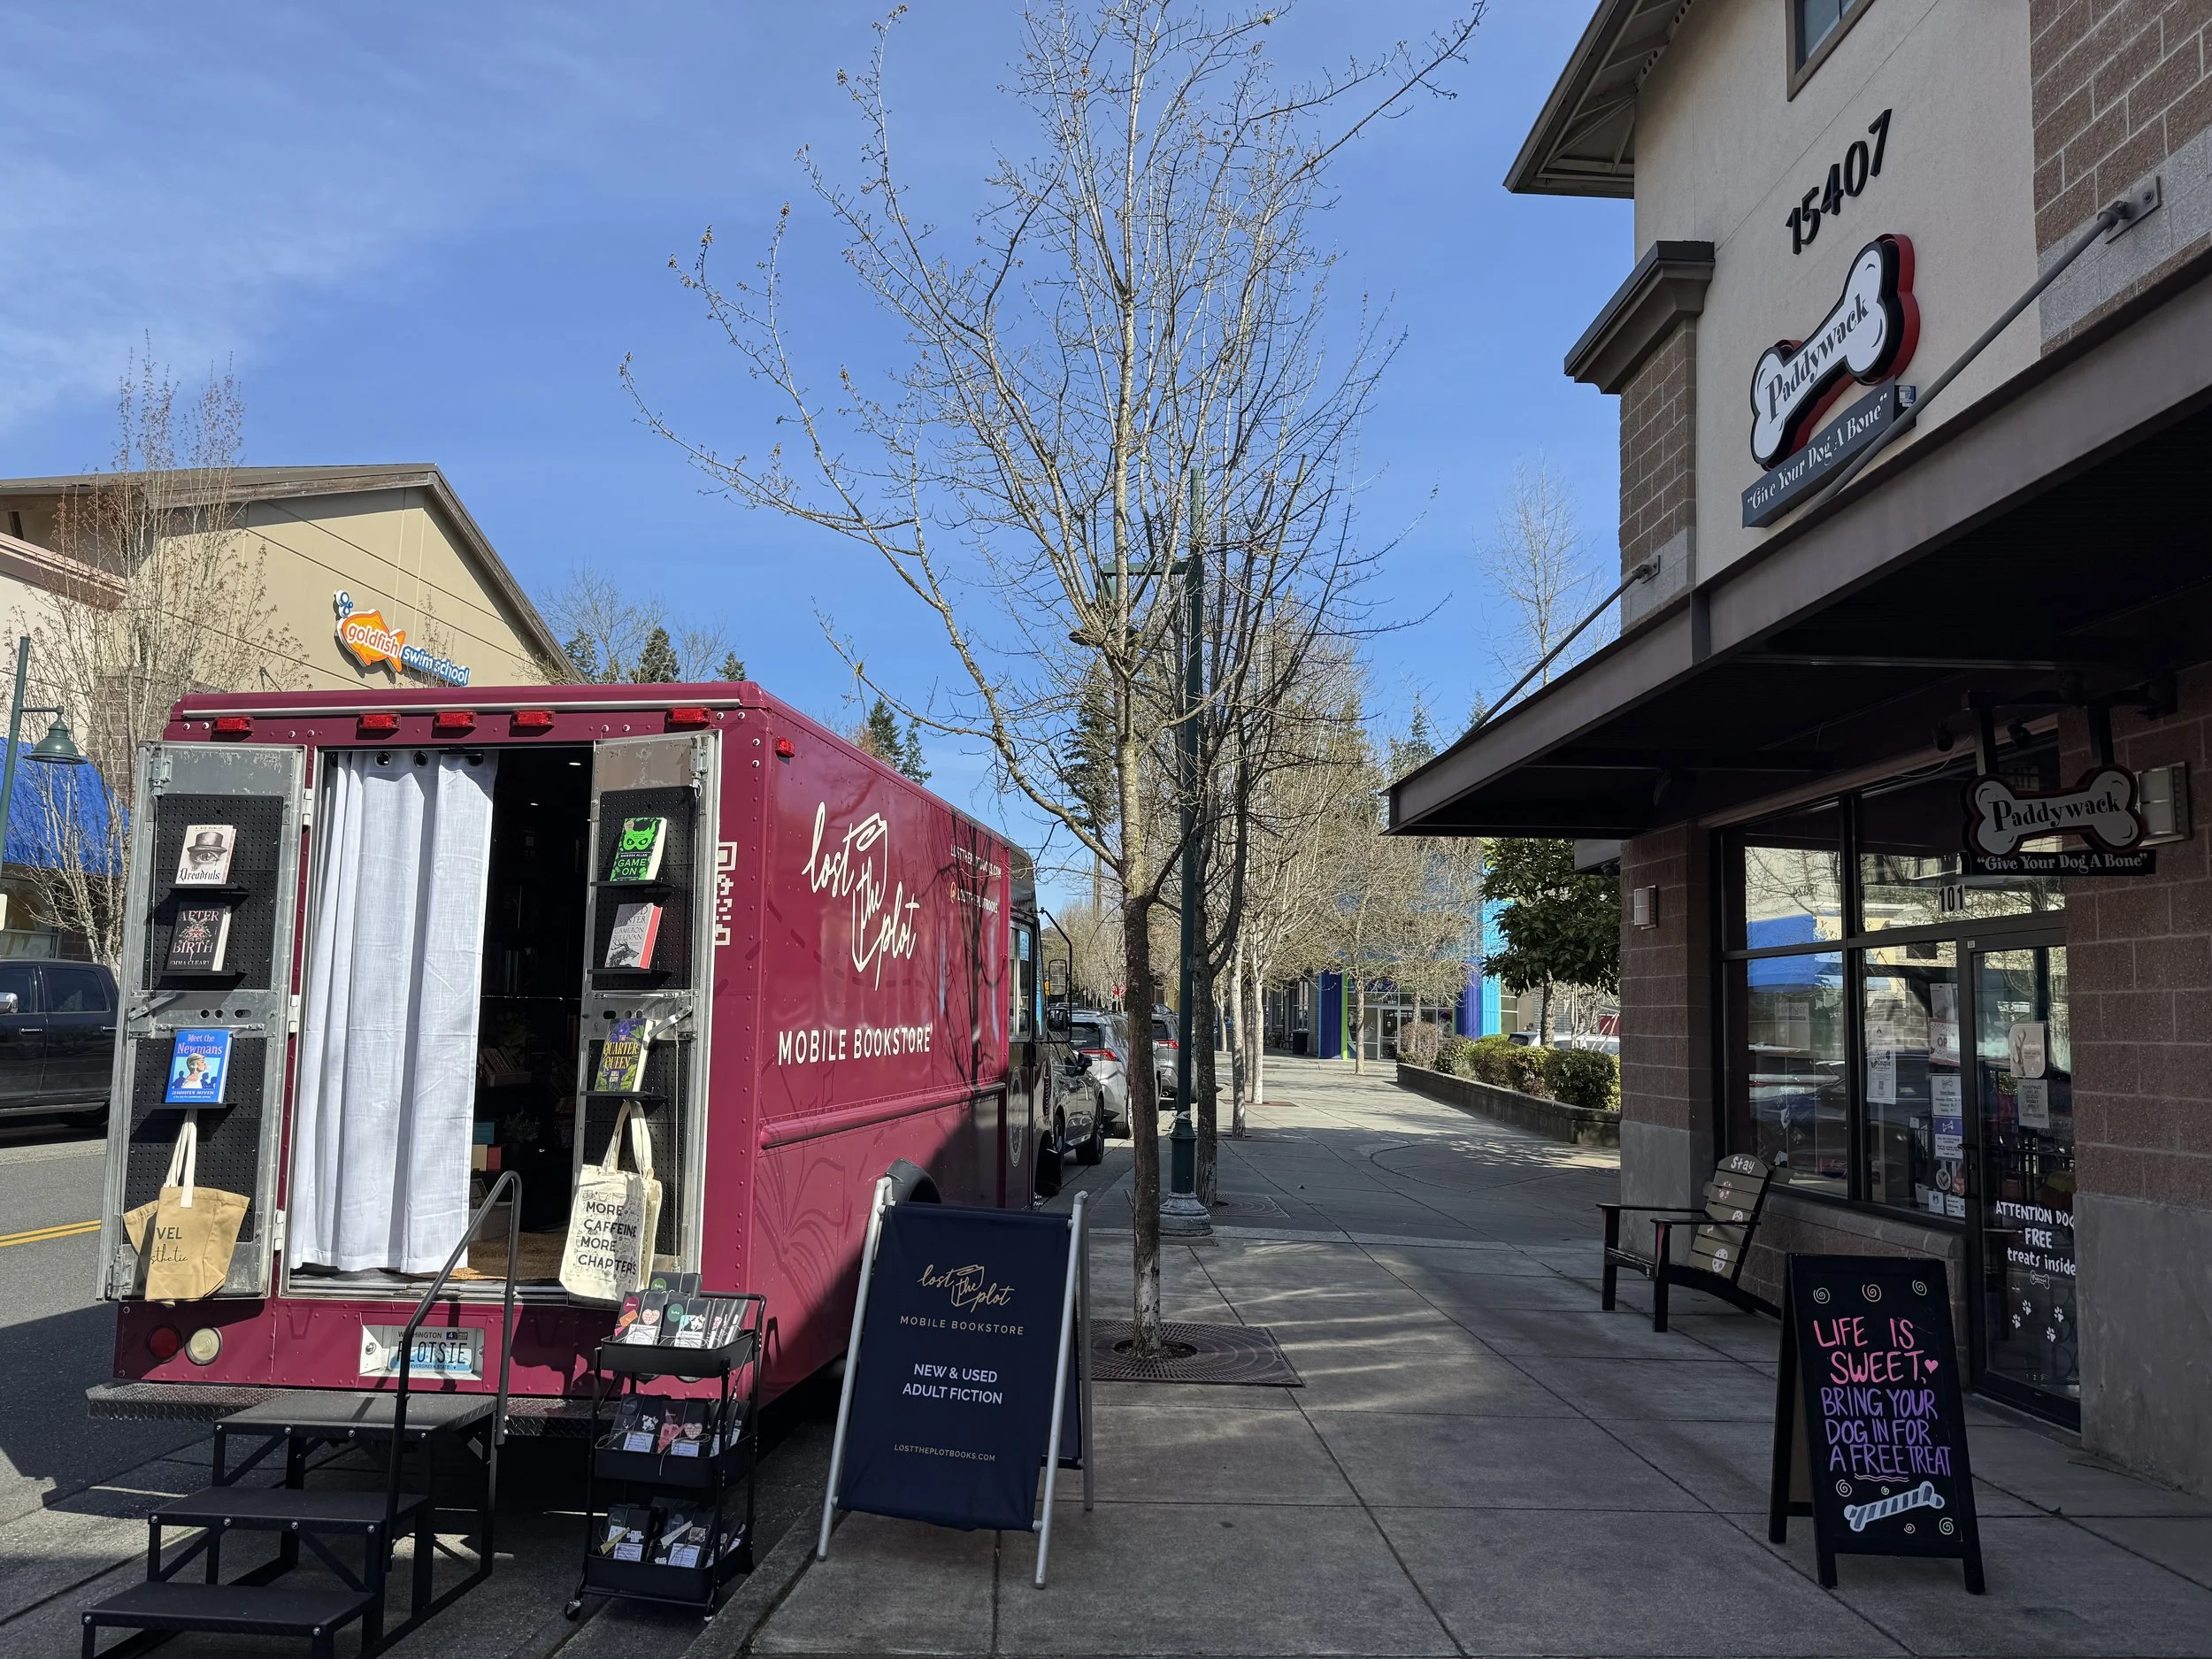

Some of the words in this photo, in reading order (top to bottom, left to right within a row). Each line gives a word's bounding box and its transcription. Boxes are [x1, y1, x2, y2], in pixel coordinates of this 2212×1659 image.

[1786, 108, 1893, 255] 15407
[1765, 293, 1870, 424] Paddywack
[1776, 459, 1806, 491] Your
[1807, 435, 1832, 466] Dog
[1832, 426, 1845, 450] A
[348, 625, 398, 657] goldfish
[403, 648, 433, 669] swim
[435, 658, 470, 683] school
[1987, 792, 2121, 833] Paddywack
[801, 801, 856, 898] lost
[618, 858, 648, 867] GAME
[621, 867, 637, 876] ON
[2018, 856, 2055, 870] Your
[2059, 855, 2089, 874] Dog
[2090, 855, 2102, 868] A
[1939, 885, 1964, 912] 101
[179, 910, 219, 921] AFTER
[173, 941, 213, 954] BIRTH
[875, 880, 920, 992] plot
[177, 1042, 223, 1055] Newmans
[188, 1033, 203, 1042] Meet
[204, 1033, 215, 1042] the
[778, 1028, 847, 1066] MOBILE
[853, 1026, 931, 1060] BOOKSTORE
[604, 1056, 631, 1070] QUEEN
[1730, 1156, 1755, 1174] Stay
[586, 1201, 624, 1217] MORE
[1995, 1200, 2052, 1225] ATTENTION
[584, 1218, 637, 1238] CAFFEINE
[2024, 1227, 2053, 1249] FREE
[580, 1236, 618, 1252] MORE
[578, 1254, 637, 1275] CHAPTERS
[2007, 1247, 2040, 1267] treats
[2045, 1254, 2077, 1276] inside
[917, 1263, 955, 1287] lost
[970, 1282, 1015, 1313] plot
[900, 1315, 946, 1329] MOBILE
[951, 1320, 1024, 1335] BOOKSTORE
[1814, 1317, 1868, 1348] LIFE
[1890, 1317, 1915, 1349] IS
[396, 1340, 467, 1364] POTSIE
[914, 1363, 947, 1379] NEW
[949, 1366, 958, 1379] &
[962, 1368, 998, 1383] USED
[902, 1383, 948, 1399] ADULT
[949, 1387, 1002, 1405] FICTION
[1820, 1386, 1883, 1417] BRING
[1886, 1388, 1938, 1420] YOUR
[1825, 1418, 1868, 1445] DOG
[1872, 1418, 1889, 1442] IN
[1893, 1418, 1932, 1446] FOR
[894, 1444, 995, 1462] LOSTTHEPLOTBOOKS.COM
[1829, 1445, 1847, 1472] A
[1850, 1444, 1909, 1474] FREE
[1909, 1446, 1951, 1477] TREAT
